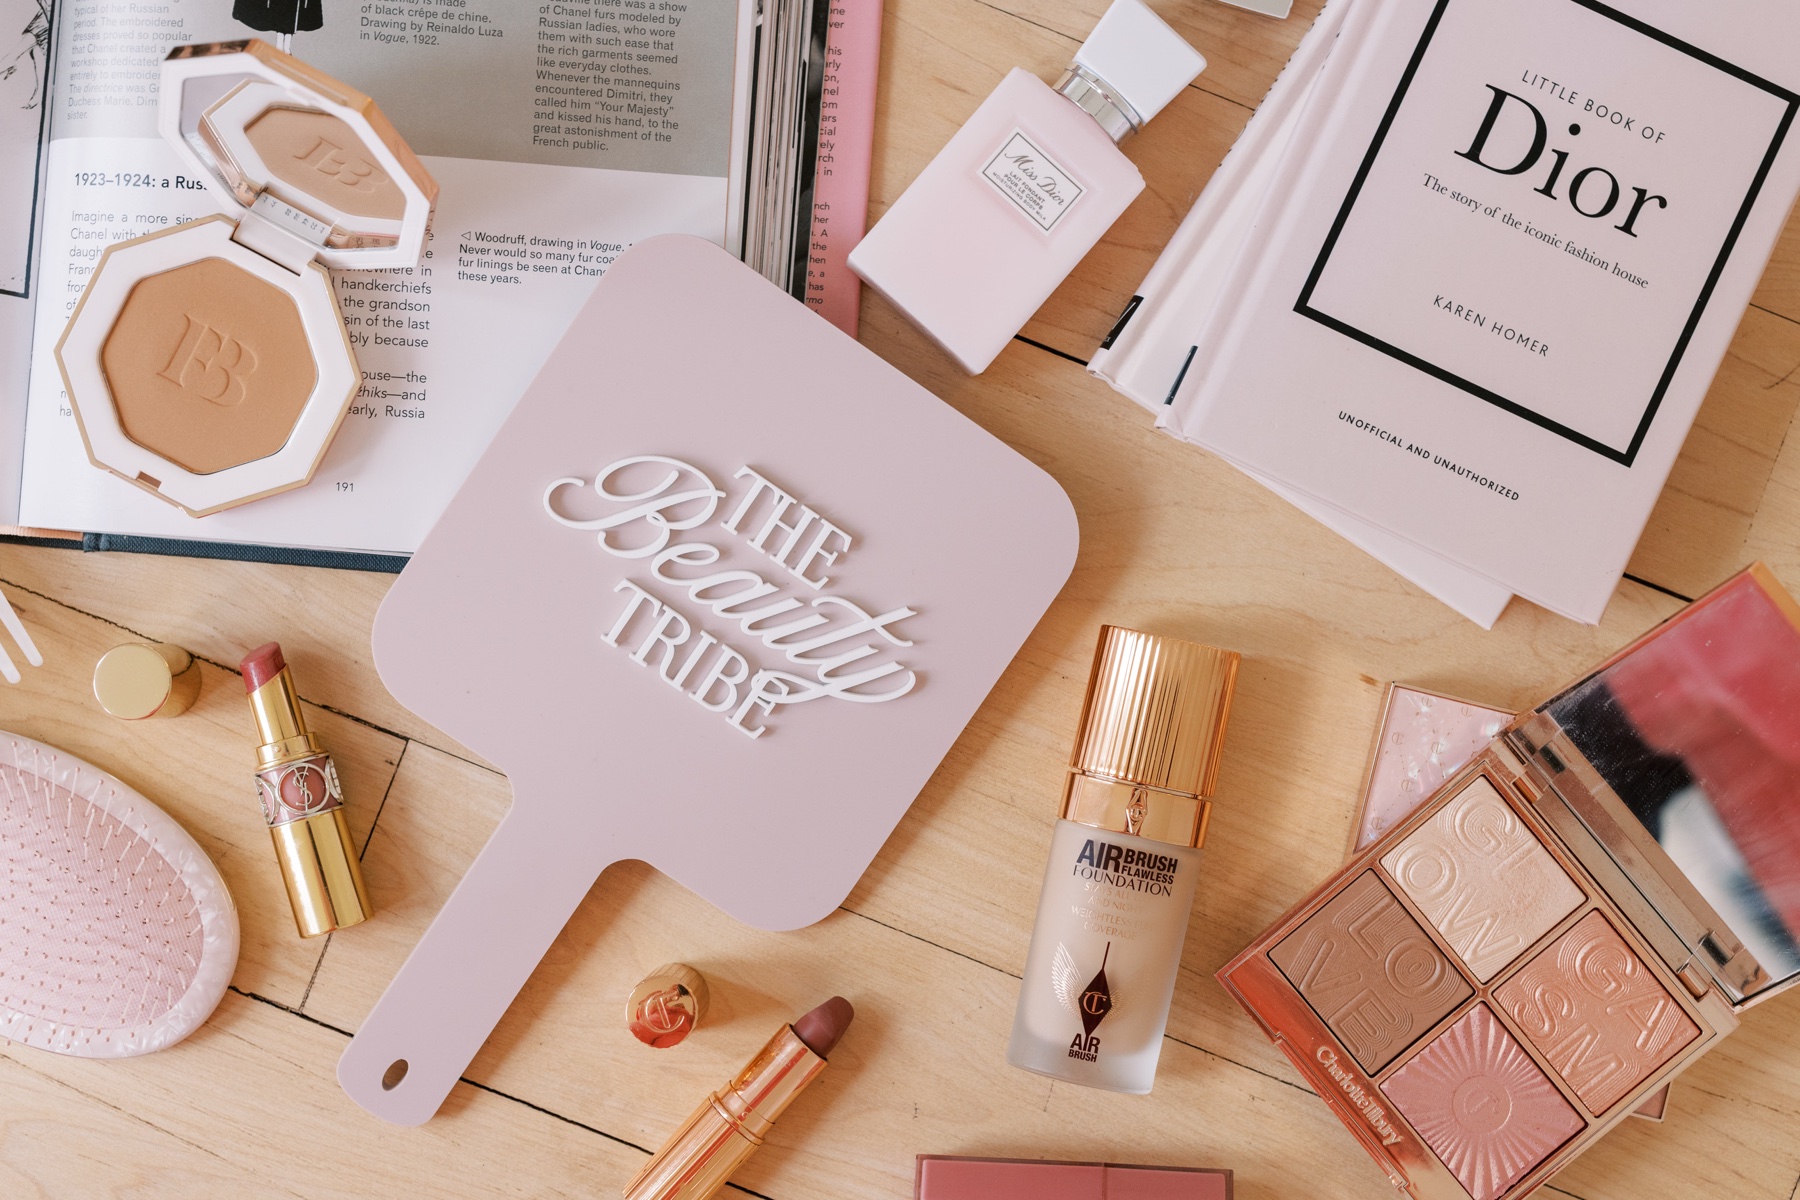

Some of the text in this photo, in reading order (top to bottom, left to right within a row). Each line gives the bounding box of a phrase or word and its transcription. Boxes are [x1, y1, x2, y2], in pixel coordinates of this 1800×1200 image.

[75, 3, 169, 17] typical Russian
[361, 4, 373, 14] of
[375, 5, 405, 16] black
[442, 10, 455, 20] de
[458, 12, 492, 23] chine.
[625, 1, 687, 12] was show
[120, 17, 184, 28] embroidered
[539, 5, 681, 27] of Chanel furs modeled by
[361, 17, 503, 38] Drawing by Reinaldo Luza
[539, 17, 676, 38] Russian ladies, who wore
[73, 32, 100, 42] dresses
[152, 31, 192, 44] popular
[360, 30, 440, 46] in Vogue, 1922.
[538, 31, 674, 51] them with such ease that
[87, 43, 157, 54] Chanel created
[537, 44, 678, 64] the rich garments seemed
[110, 57, 158, 67] dedicated
[537, 56, 652, 75] like everyday clothes.
[536, 69, 681, 91] Whenever the mannequins
[534, 97, 567, 108] called
[571, 99, 591, 110] him
[535, 85, 673, 105] encountered Dimitri, they
[67, 111, 88, 120] sister.
[1522, 70, 1666, 144] LITTLE BOOK OF
[534, 111, 554, 121] and
[558, 111, 592, 123] kissed
[595, 114, 611, 125] his
[648, 119, 658, 129] to
[662, 119, 679, 130] the
[533, 124, 672, 142] great astonishment of the
[533, 135, 609, 151] French public.
[1454, 83, 1668, 238] Dior
[161, 178, 169, 188] a
[1004, 153, 1065, 206] Miss Dior
[1009, 171, 1045, 204] LAIT FONDANT
[1003, 174, 1019, 189] POUR
[1026, 192, 1044, 210] CORPS
[71, 211, 168, 225] Imagine more
[71, 227, 107, 240] Chanel
[112, 228, 137, 240] with
[1423, 173, 1649, 289] The story of the iconic fashion house
[475, 232, 587, 250] Woodruff, drawing in
[459, 244, 593, 264] Never would so many fur
[421, 265, 432, 276] in
[458, 257, 572, 275] fur linings be seen at
[341, 277, 432, 294] handkerchiefs
[458, 270, 522, 284] these years.
[344, 295, 430, 312] the grandson
[366, 315, 430, 330] of the last
[1433, 294, 1549, 357] KAREN HOMER
[375, 333, 429, 347] because
[385, 405, 425, 419] Russia
[1338, 410, 1520, 501] UNOFFICIAL AND UNAUTHORIZED
[336, 482, 354, 492] 191
[720, 464, 853, 591] THE
[542, 454, 918, 704] Beauty
[600, 577, 790, 742] TRIBE
[1073, 864, 1173, 897] FOUNDATION
[1121, 865, 1174, 885] FLAWLESS
[1070, 1033, 1101, 1054] AIR
[1068, 1049, 1098, 1063] BRUSH
